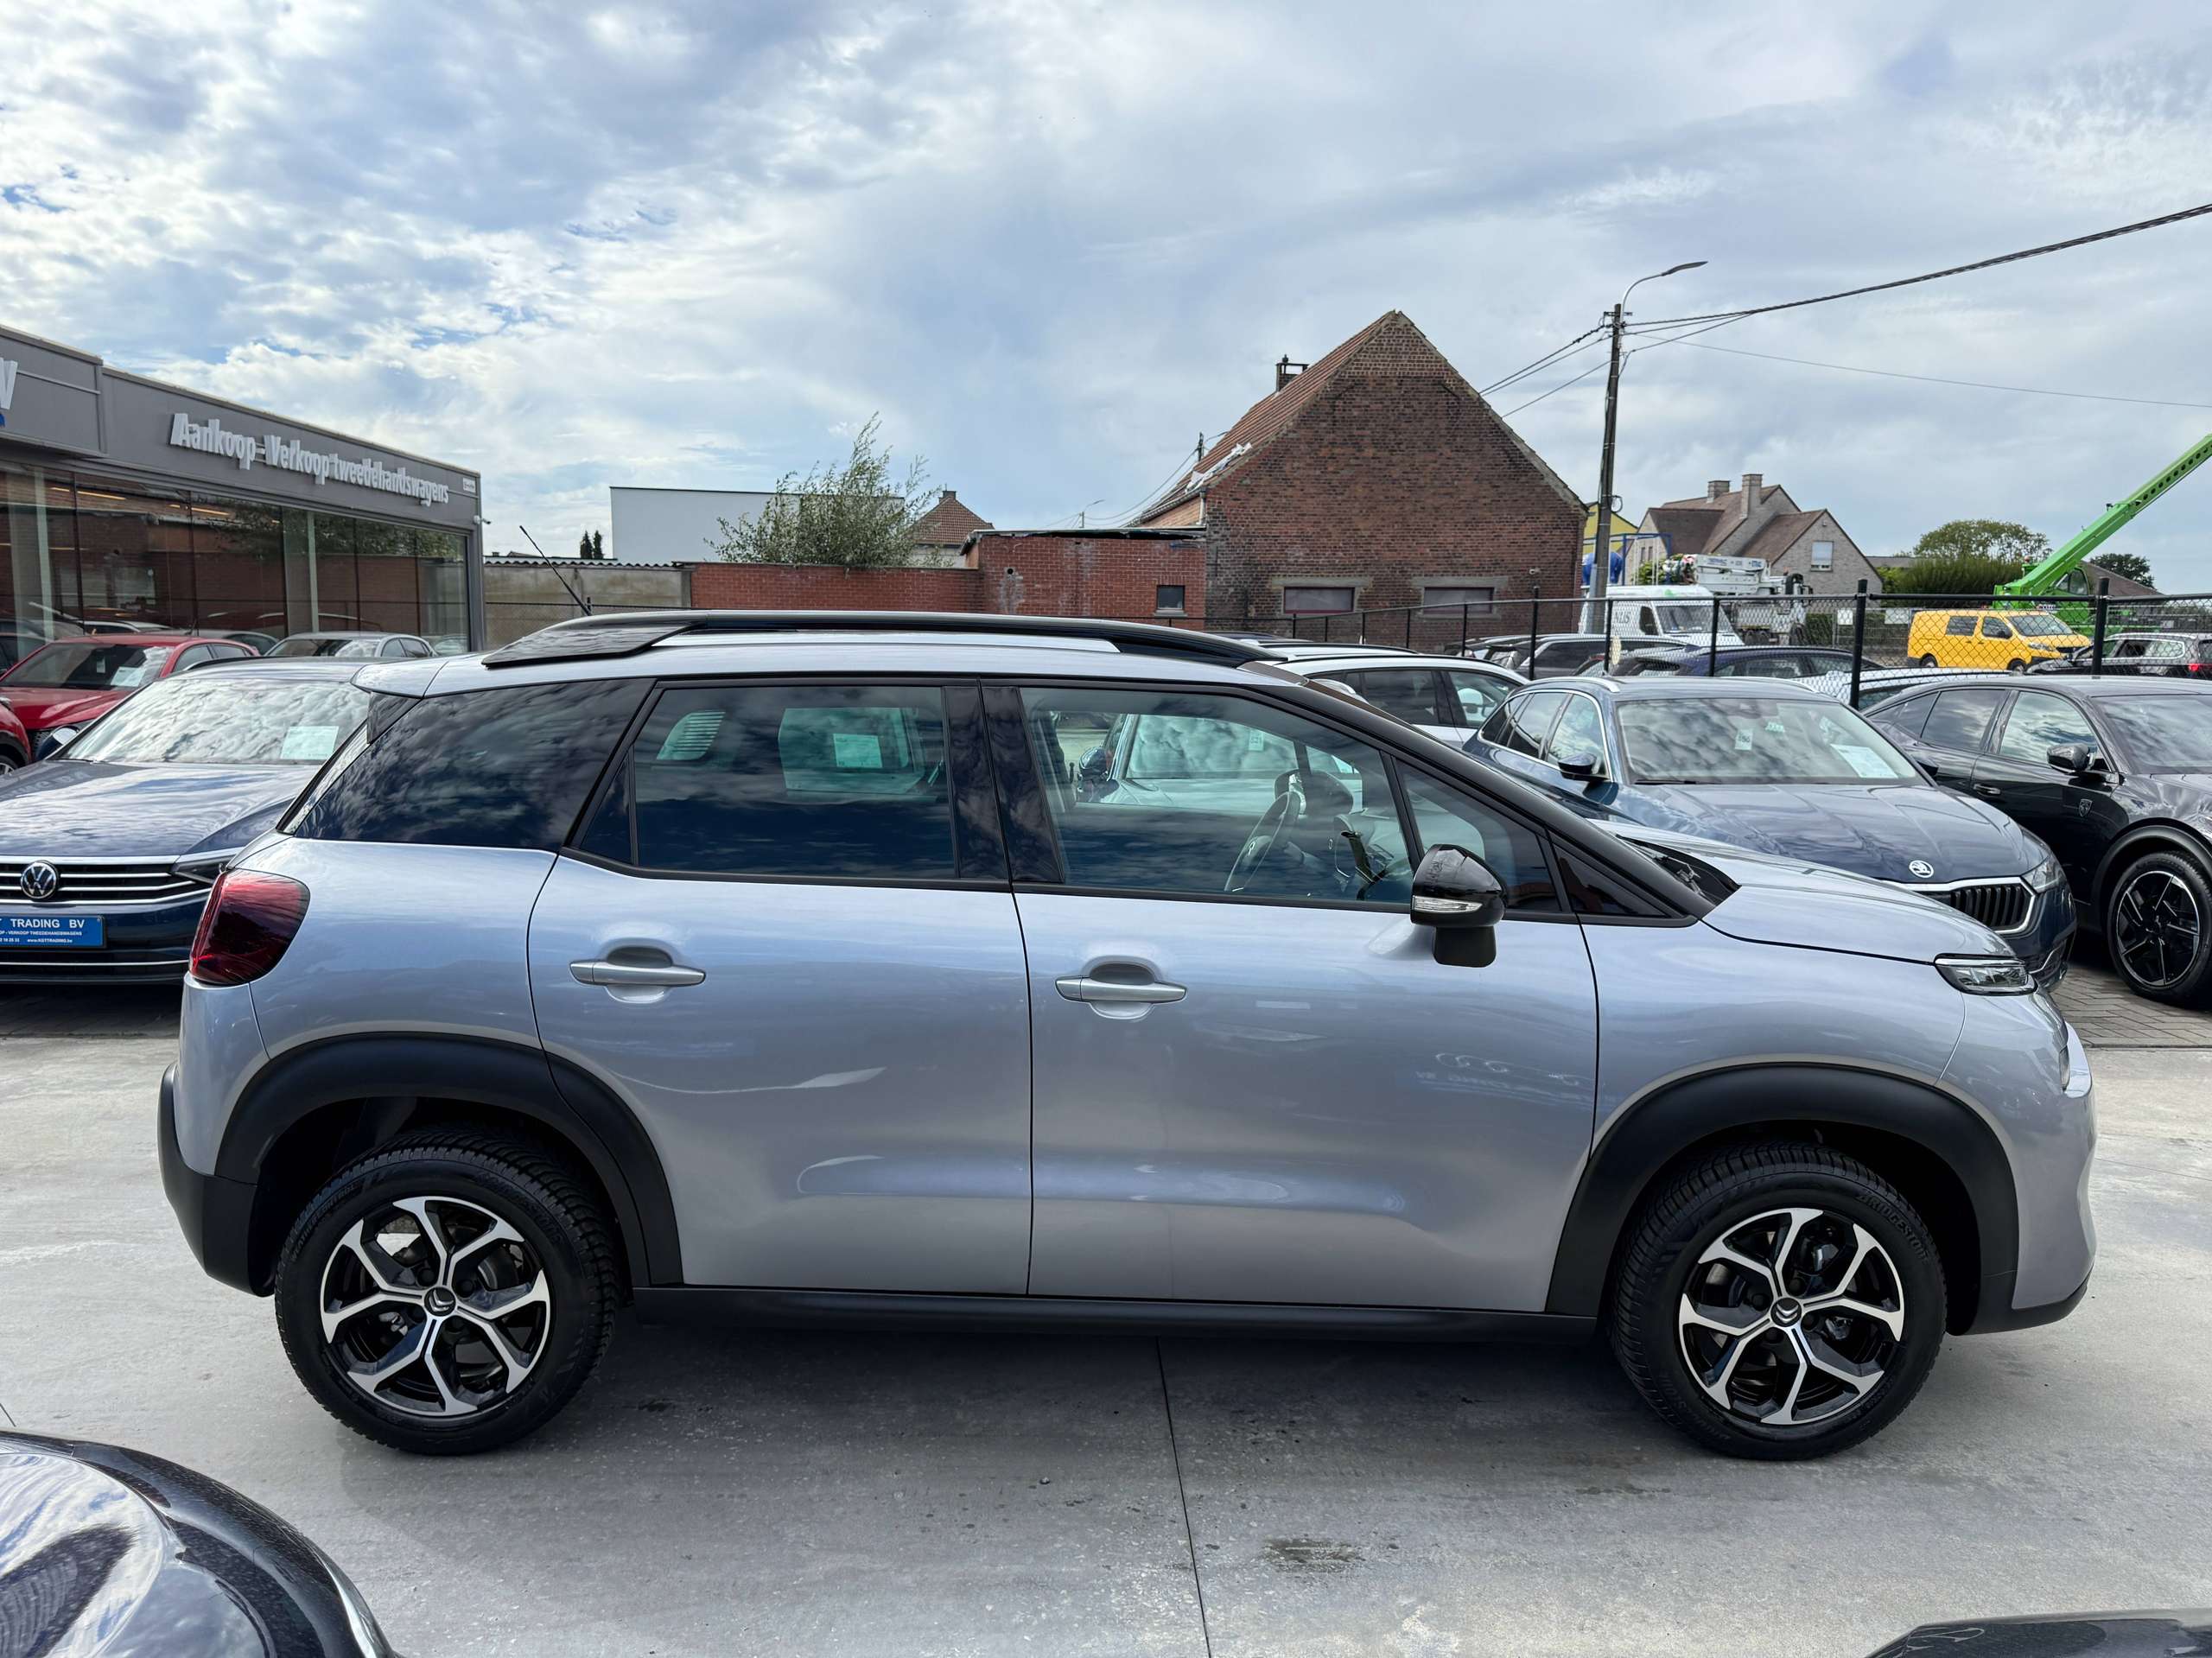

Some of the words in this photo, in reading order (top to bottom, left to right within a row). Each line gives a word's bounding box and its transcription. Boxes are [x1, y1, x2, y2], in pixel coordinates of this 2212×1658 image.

[170, 413, 257, 470] Aankoop
[264, 435, 330, 486] Verkoop
[329, 454, 449, 507] tweedehandswagens
[10, 918, 60, 929] TRADING
[69, 918, 85, 929] BV
